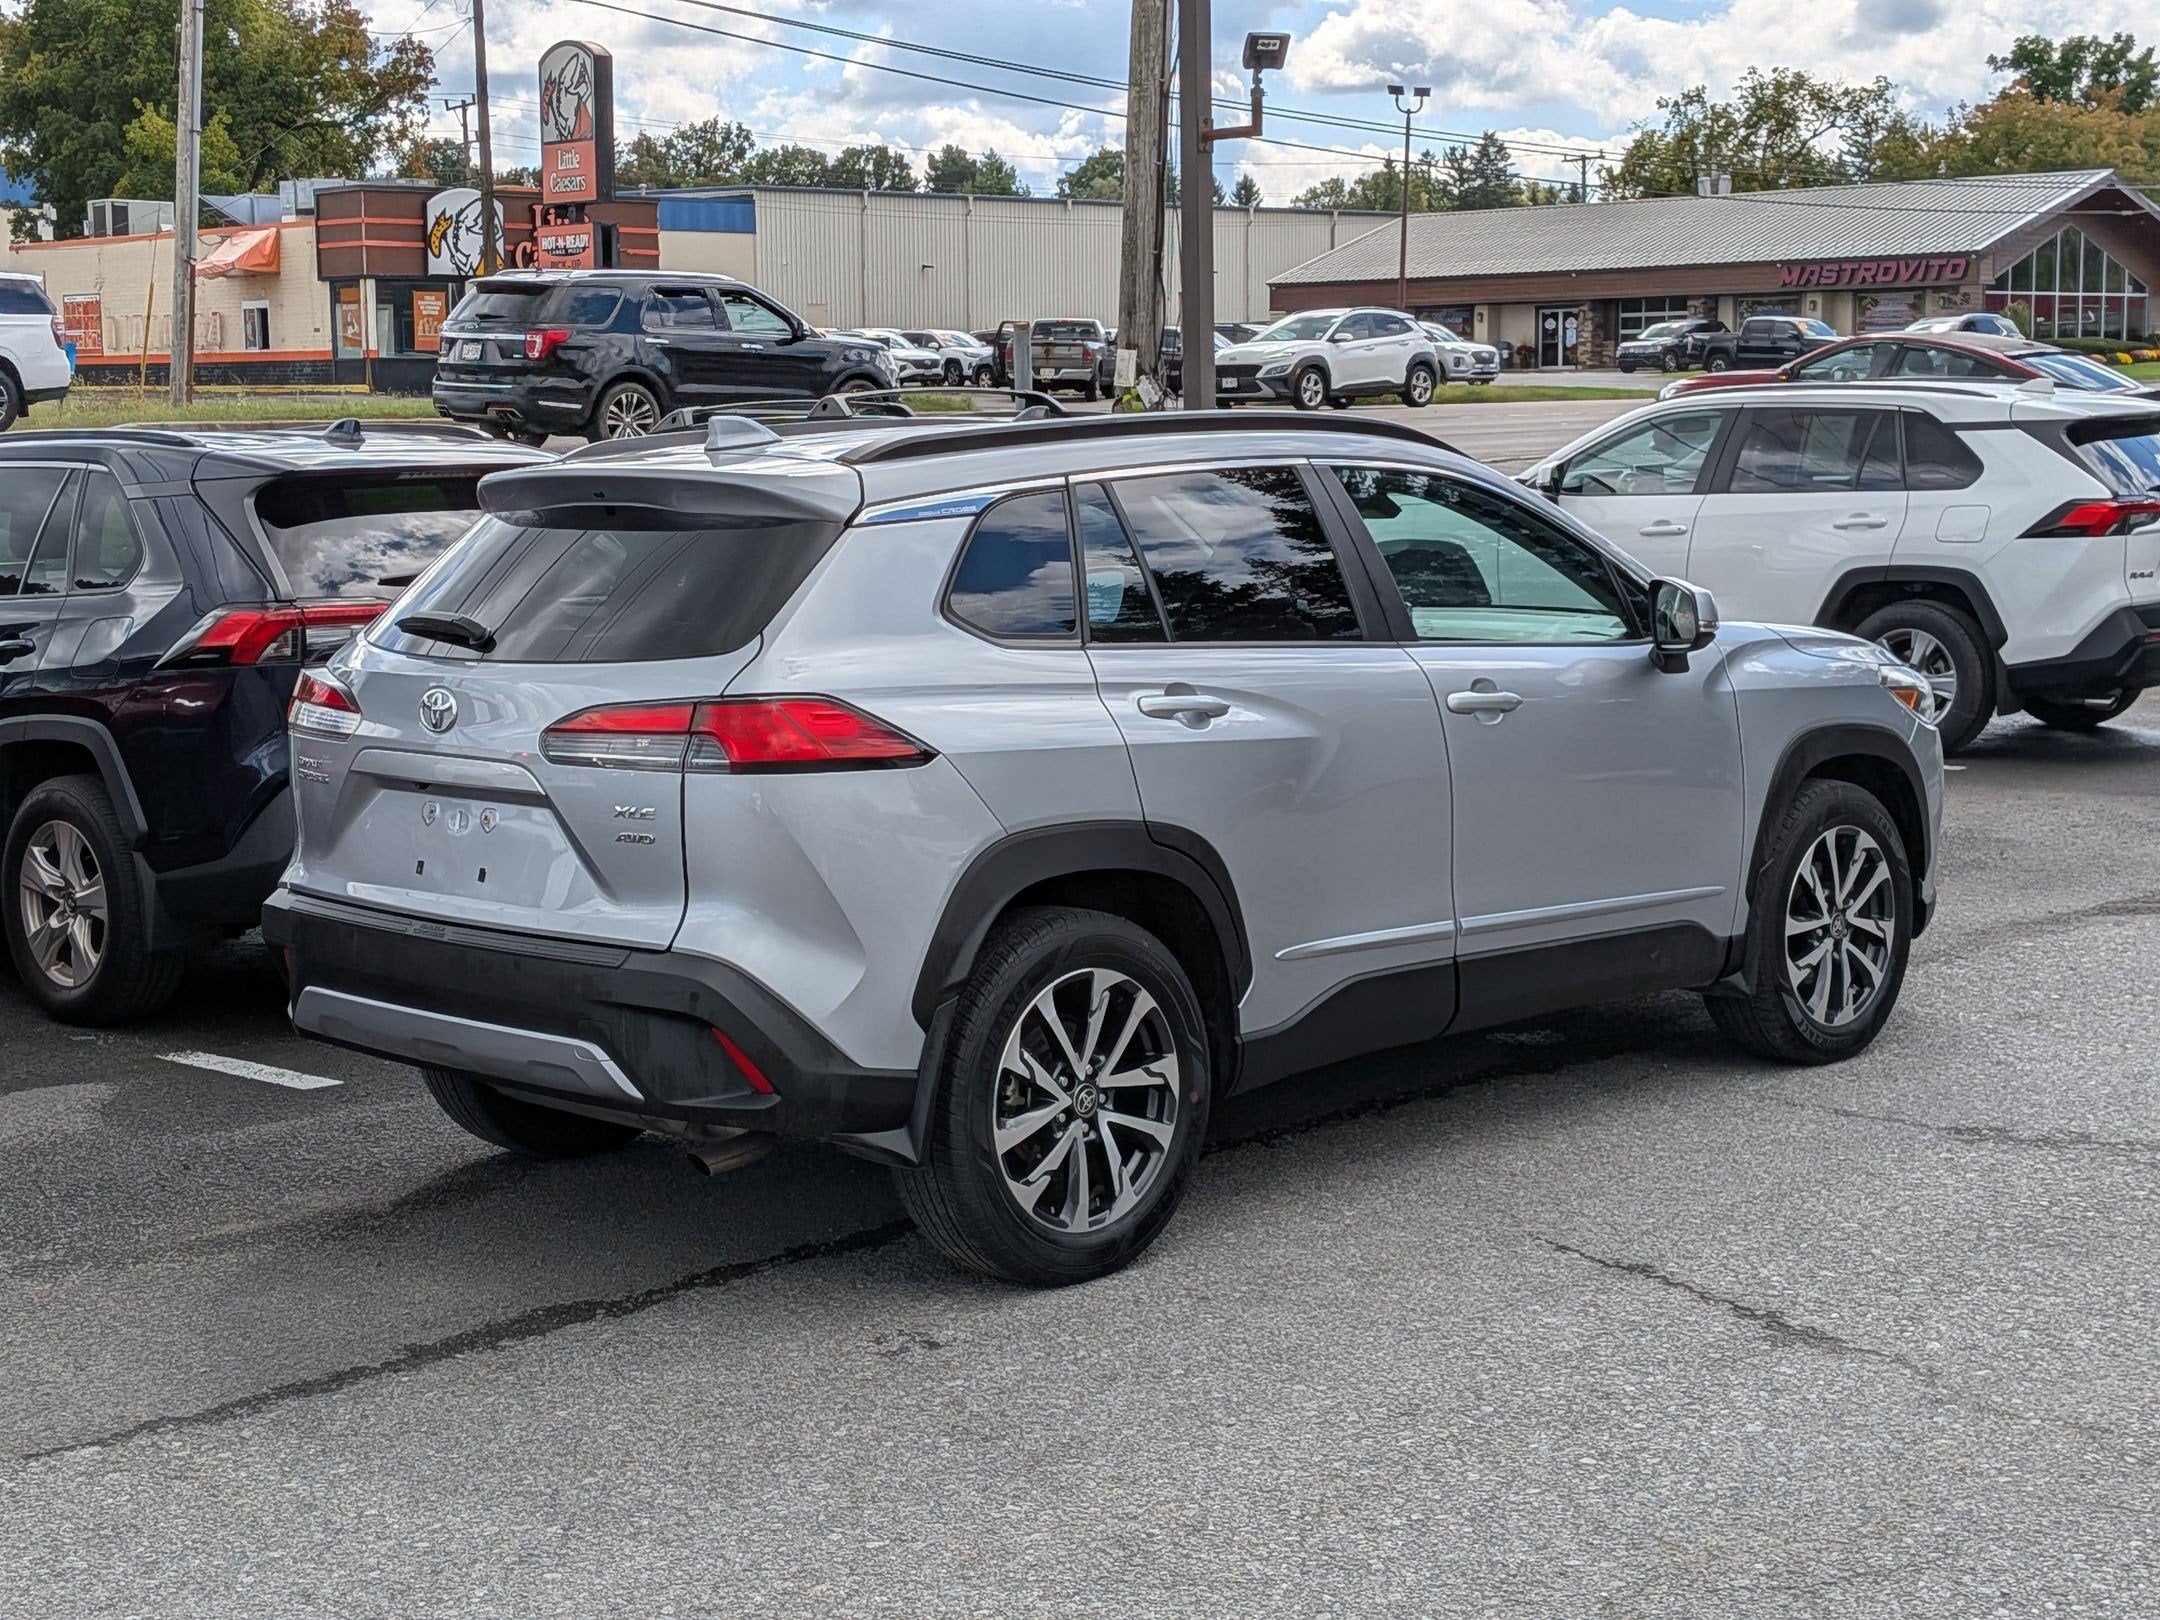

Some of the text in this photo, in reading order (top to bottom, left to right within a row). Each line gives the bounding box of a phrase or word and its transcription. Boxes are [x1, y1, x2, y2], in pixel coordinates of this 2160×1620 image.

[557, 149, 580, 170] Little
[550, 172, 586, 193] Caesars
[541, 233, 590, 250] HOT-N-READY
[1779, 258, 1969, 287] MASTROVITO
[613, 805, 656, 821] XLE
[615, 832, 656, 845] AWD
